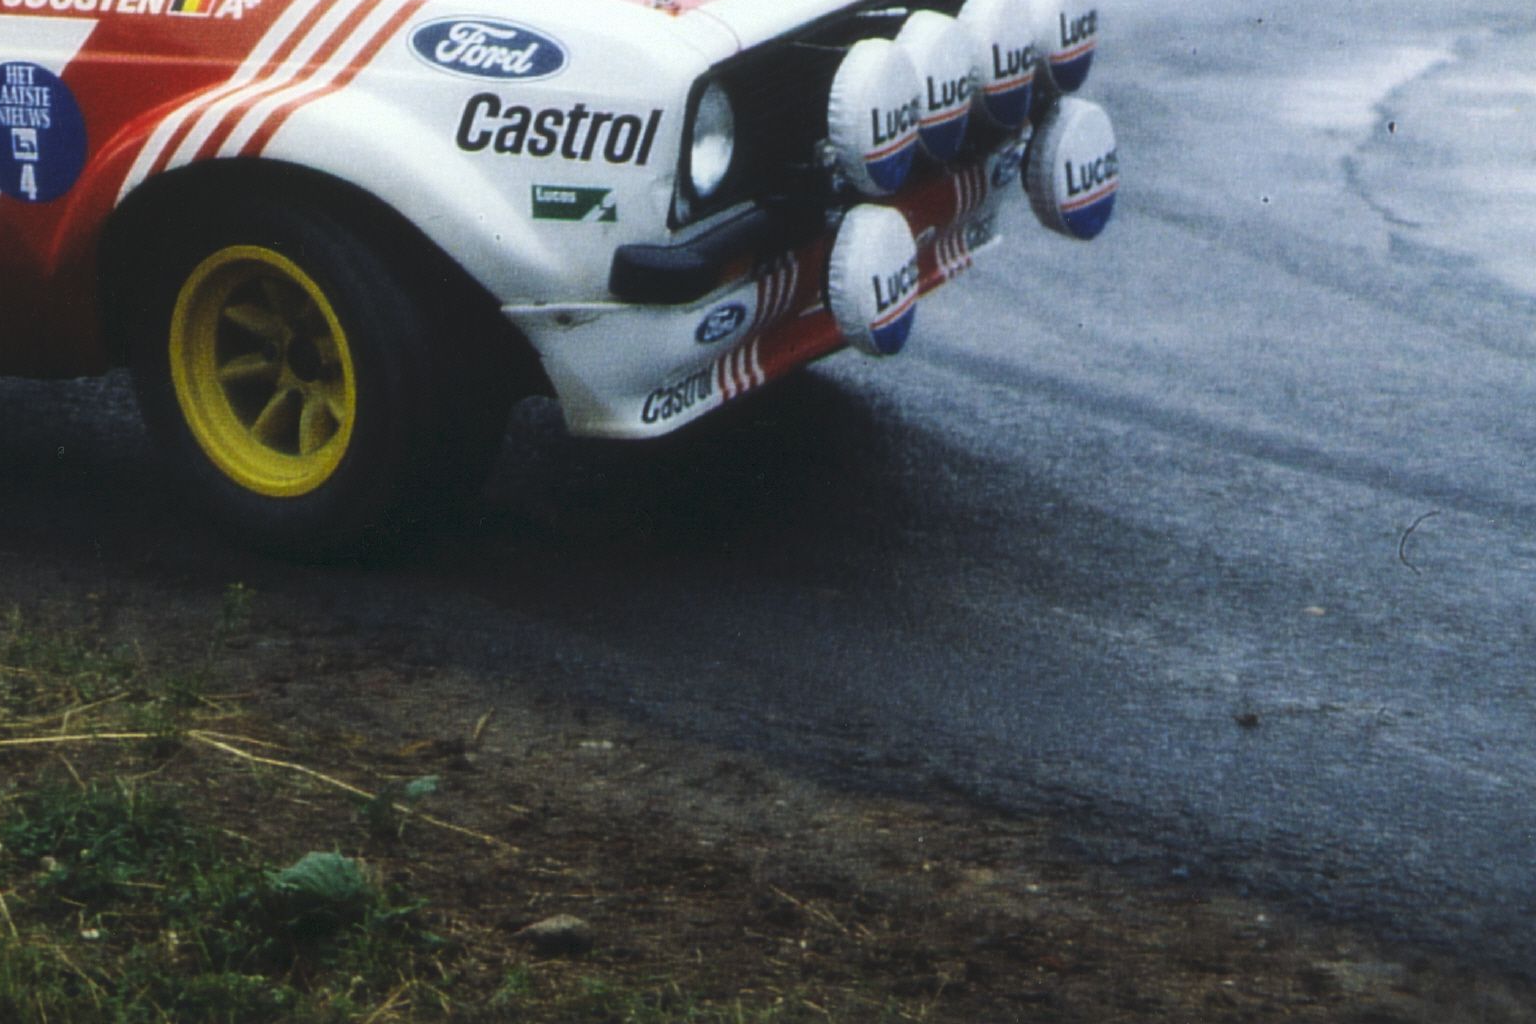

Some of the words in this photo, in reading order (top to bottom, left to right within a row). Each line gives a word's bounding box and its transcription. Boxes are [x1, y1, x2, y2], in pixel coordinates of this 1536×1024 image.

[434, 19, 535, 75] Ford
[5, 64, 35, 85] HET
[455, 92, 662, 166] Castrol
[19, 163, 38, 201] 4
